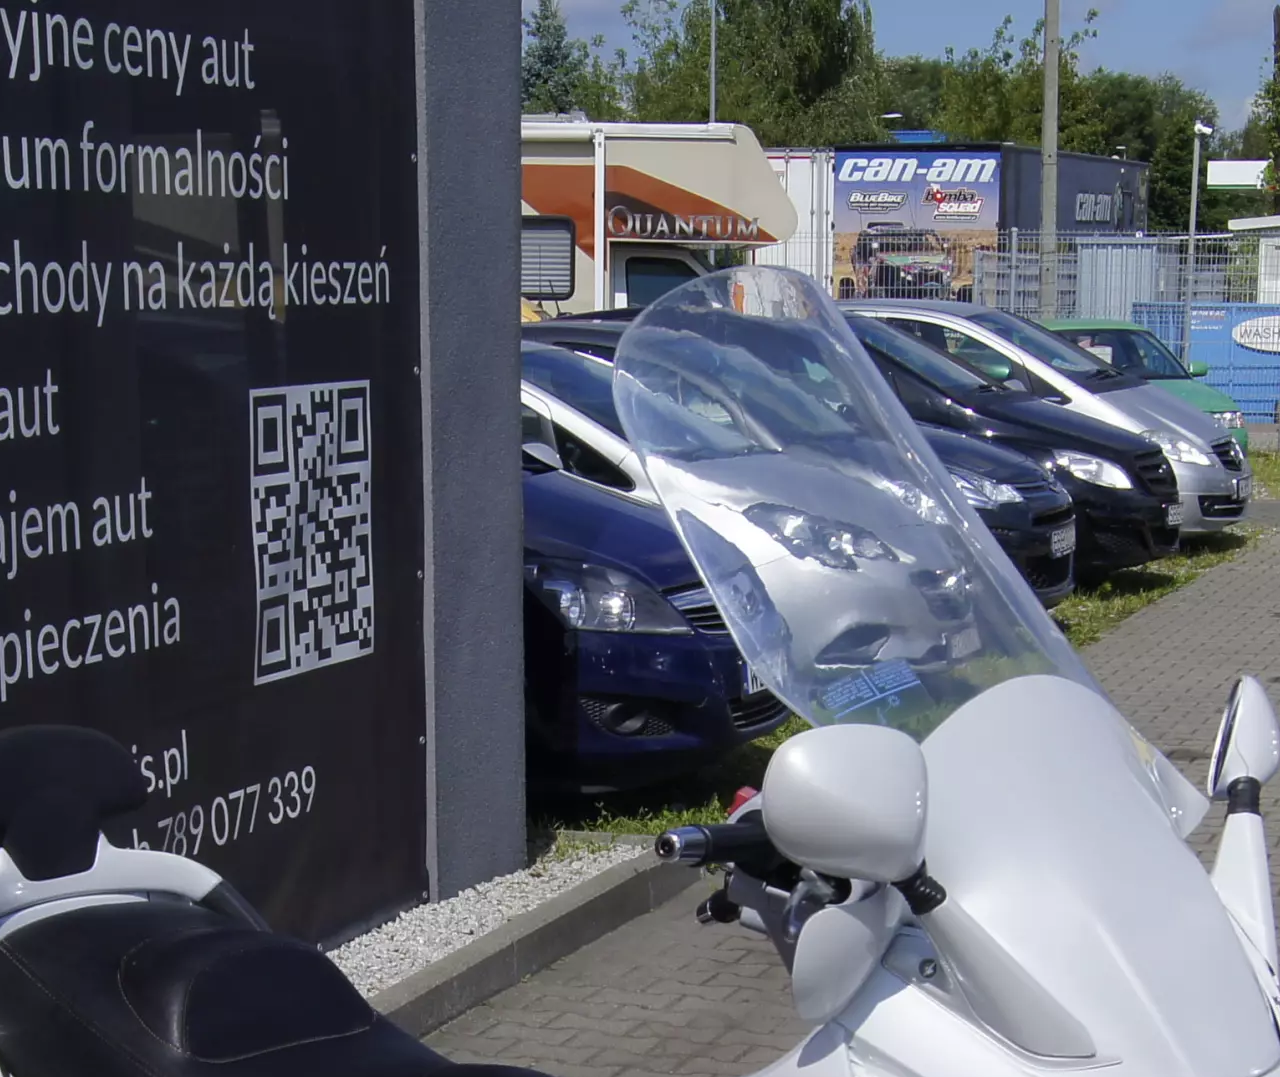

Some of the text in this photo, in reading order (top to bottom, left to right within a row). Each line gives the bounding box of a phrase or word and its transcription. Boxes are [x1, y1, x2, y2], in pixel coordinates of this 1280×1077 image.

[103, 27, 192, 96] ceny
[201, 29, 255, 90] aut
[80, 120, 289, 200] formalności
[838, 158, 997, 183] can-am
[607, 205, 760, 240] QUANTUM
[122, 262, 167, 310] na
[177, 242, 277, 320] każdą
[283, 244, 391, 306] kieszeń
[1240, 327, 1280, 340] WASH
[92, 477, 152, 546] aut
[131, 729, 188, 797] s.pl
[157, 765, 317, 857] 789 077 339
